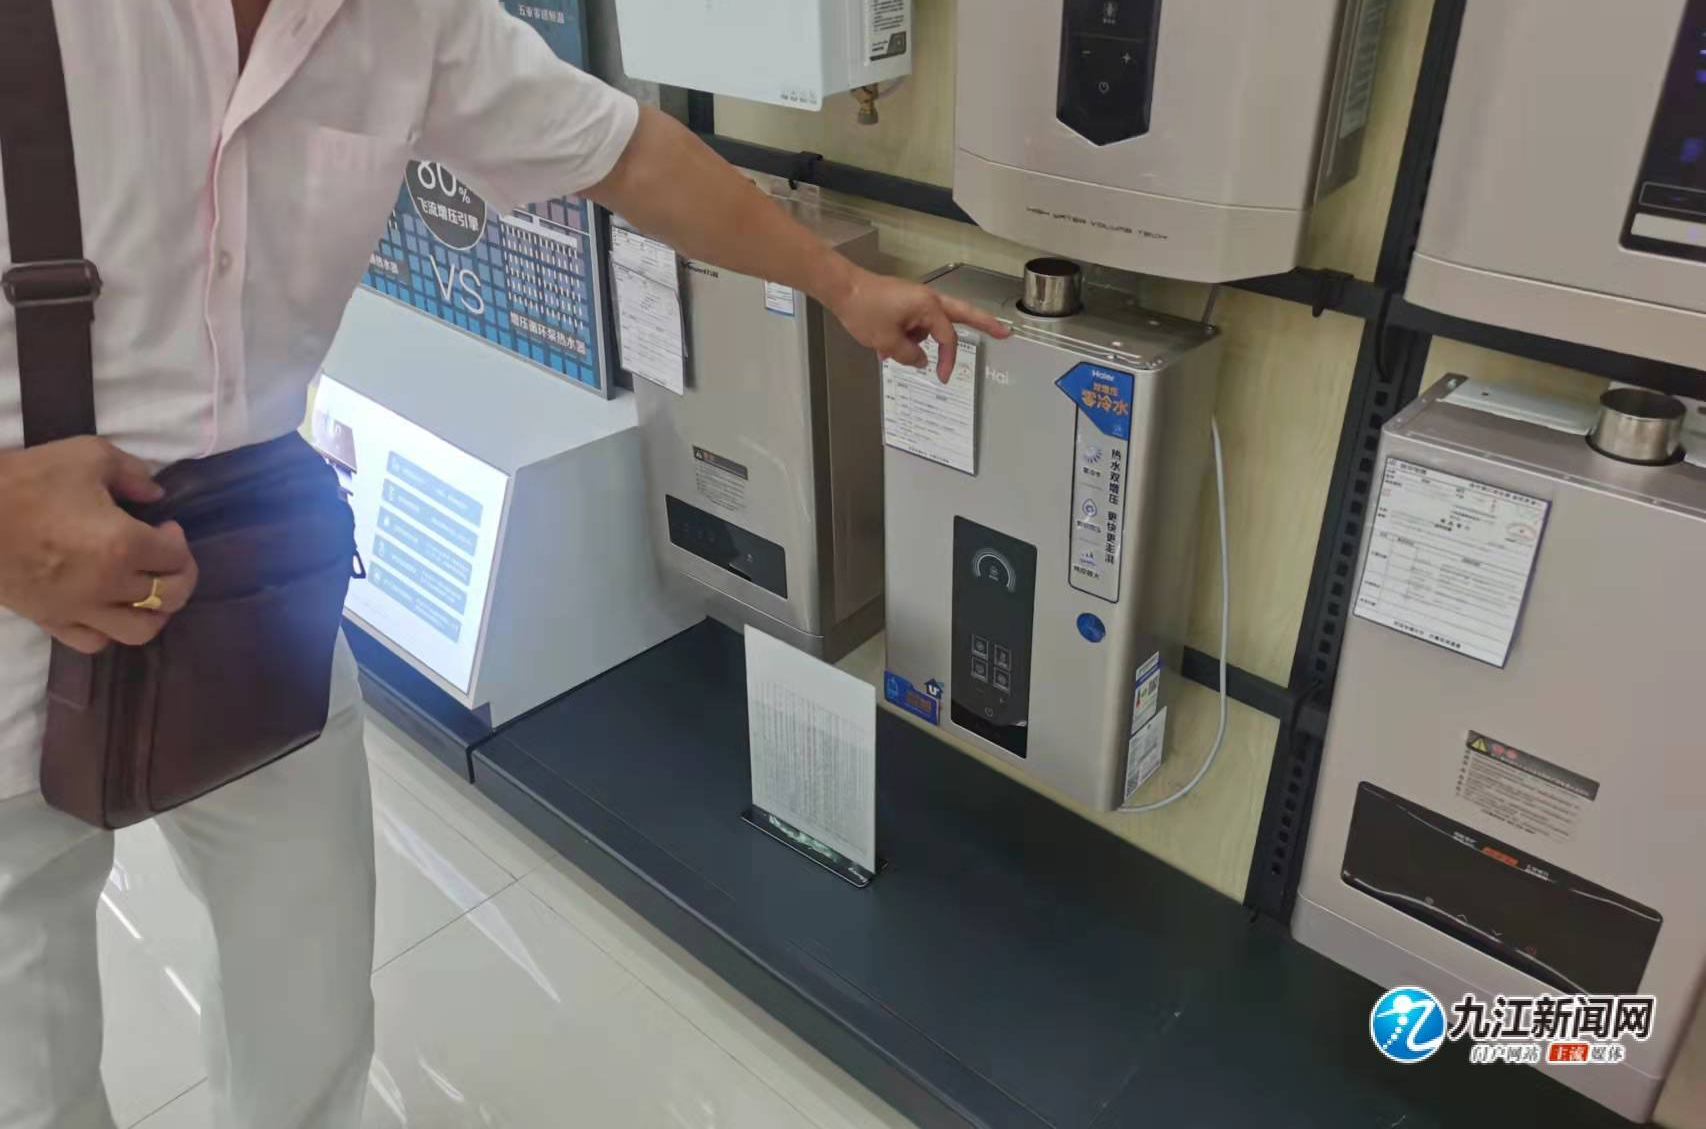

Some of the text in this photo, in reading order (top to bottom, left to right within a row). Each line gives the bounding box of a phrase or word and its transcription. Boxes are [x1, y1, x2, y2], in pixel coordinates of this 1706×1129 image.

[417, 197, 480, 232] 飞流增压引擎
[429, 254, 485, 315] VS
[1091, 369, 1115, 382] Haier
[1081, 388, 1129, 416] 零冷水
[1109, 448, 1122, 505] 热水双增压
